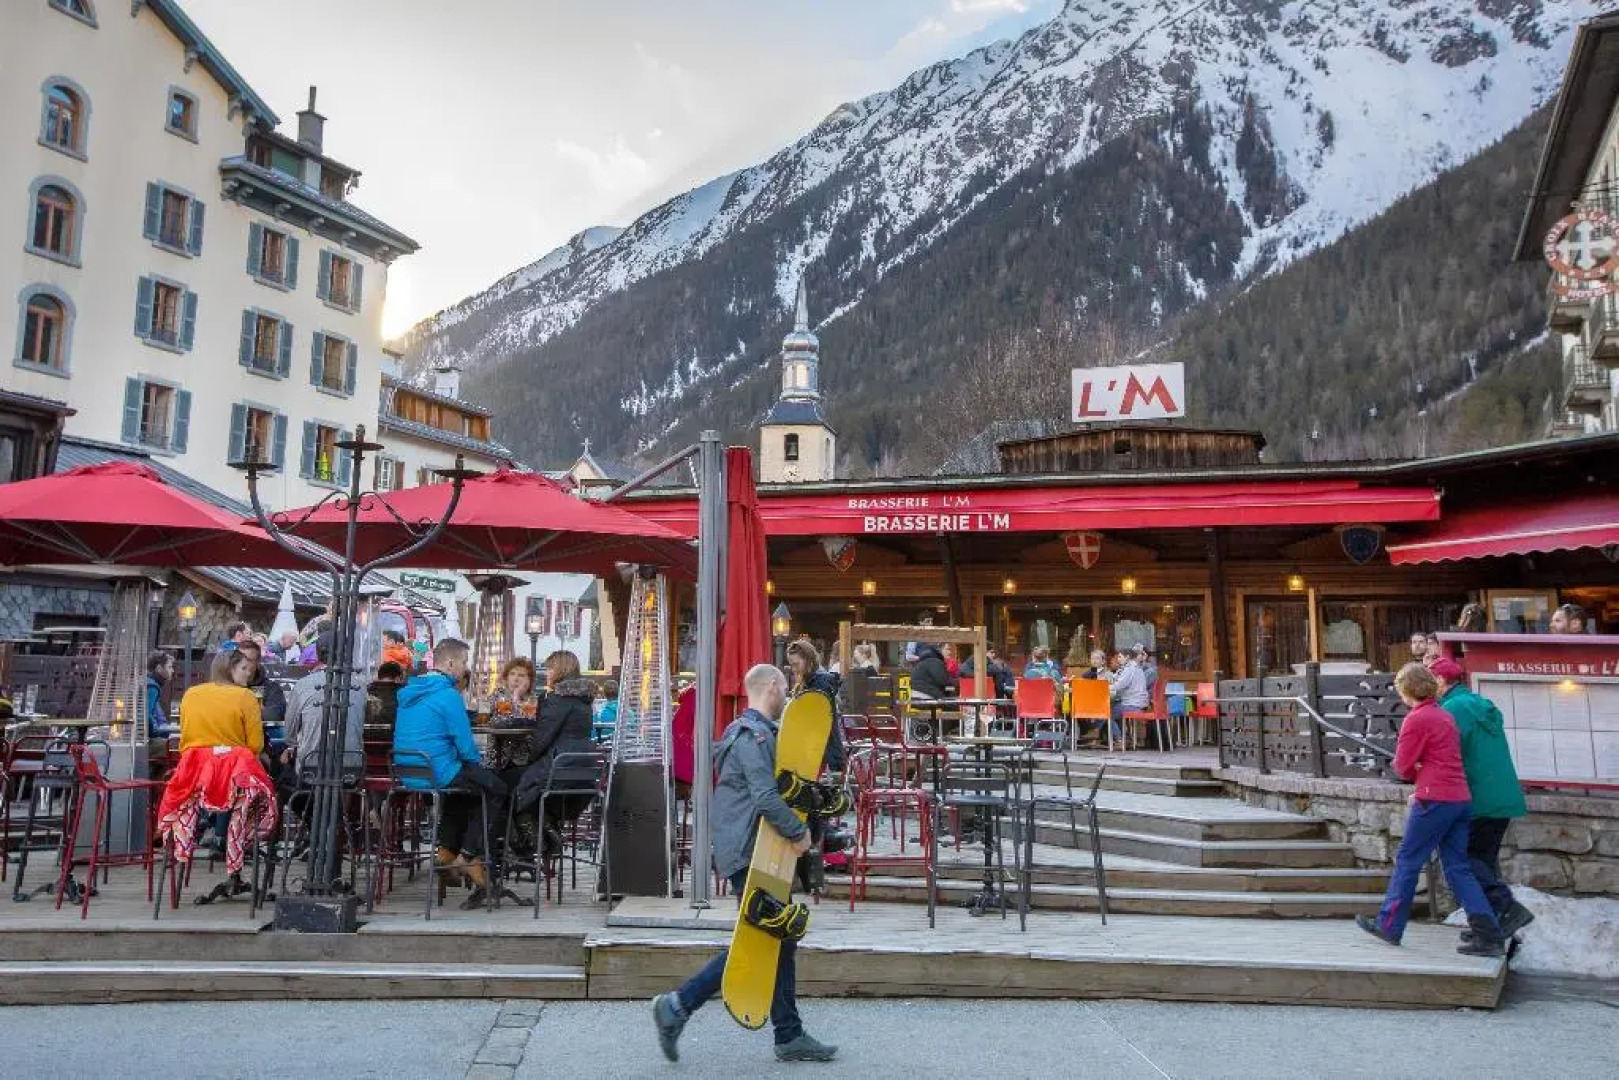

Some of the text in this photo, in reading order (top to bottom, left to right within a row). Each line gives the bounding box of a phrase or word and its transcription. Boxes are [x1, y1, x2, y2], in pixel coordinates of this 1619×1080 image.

[1078, 371, 1178, 417] L'M
[848, 495, 970, 509] BRASSERIE L'M
[864, 513, 1010, 532] BRASSERIE L'M
